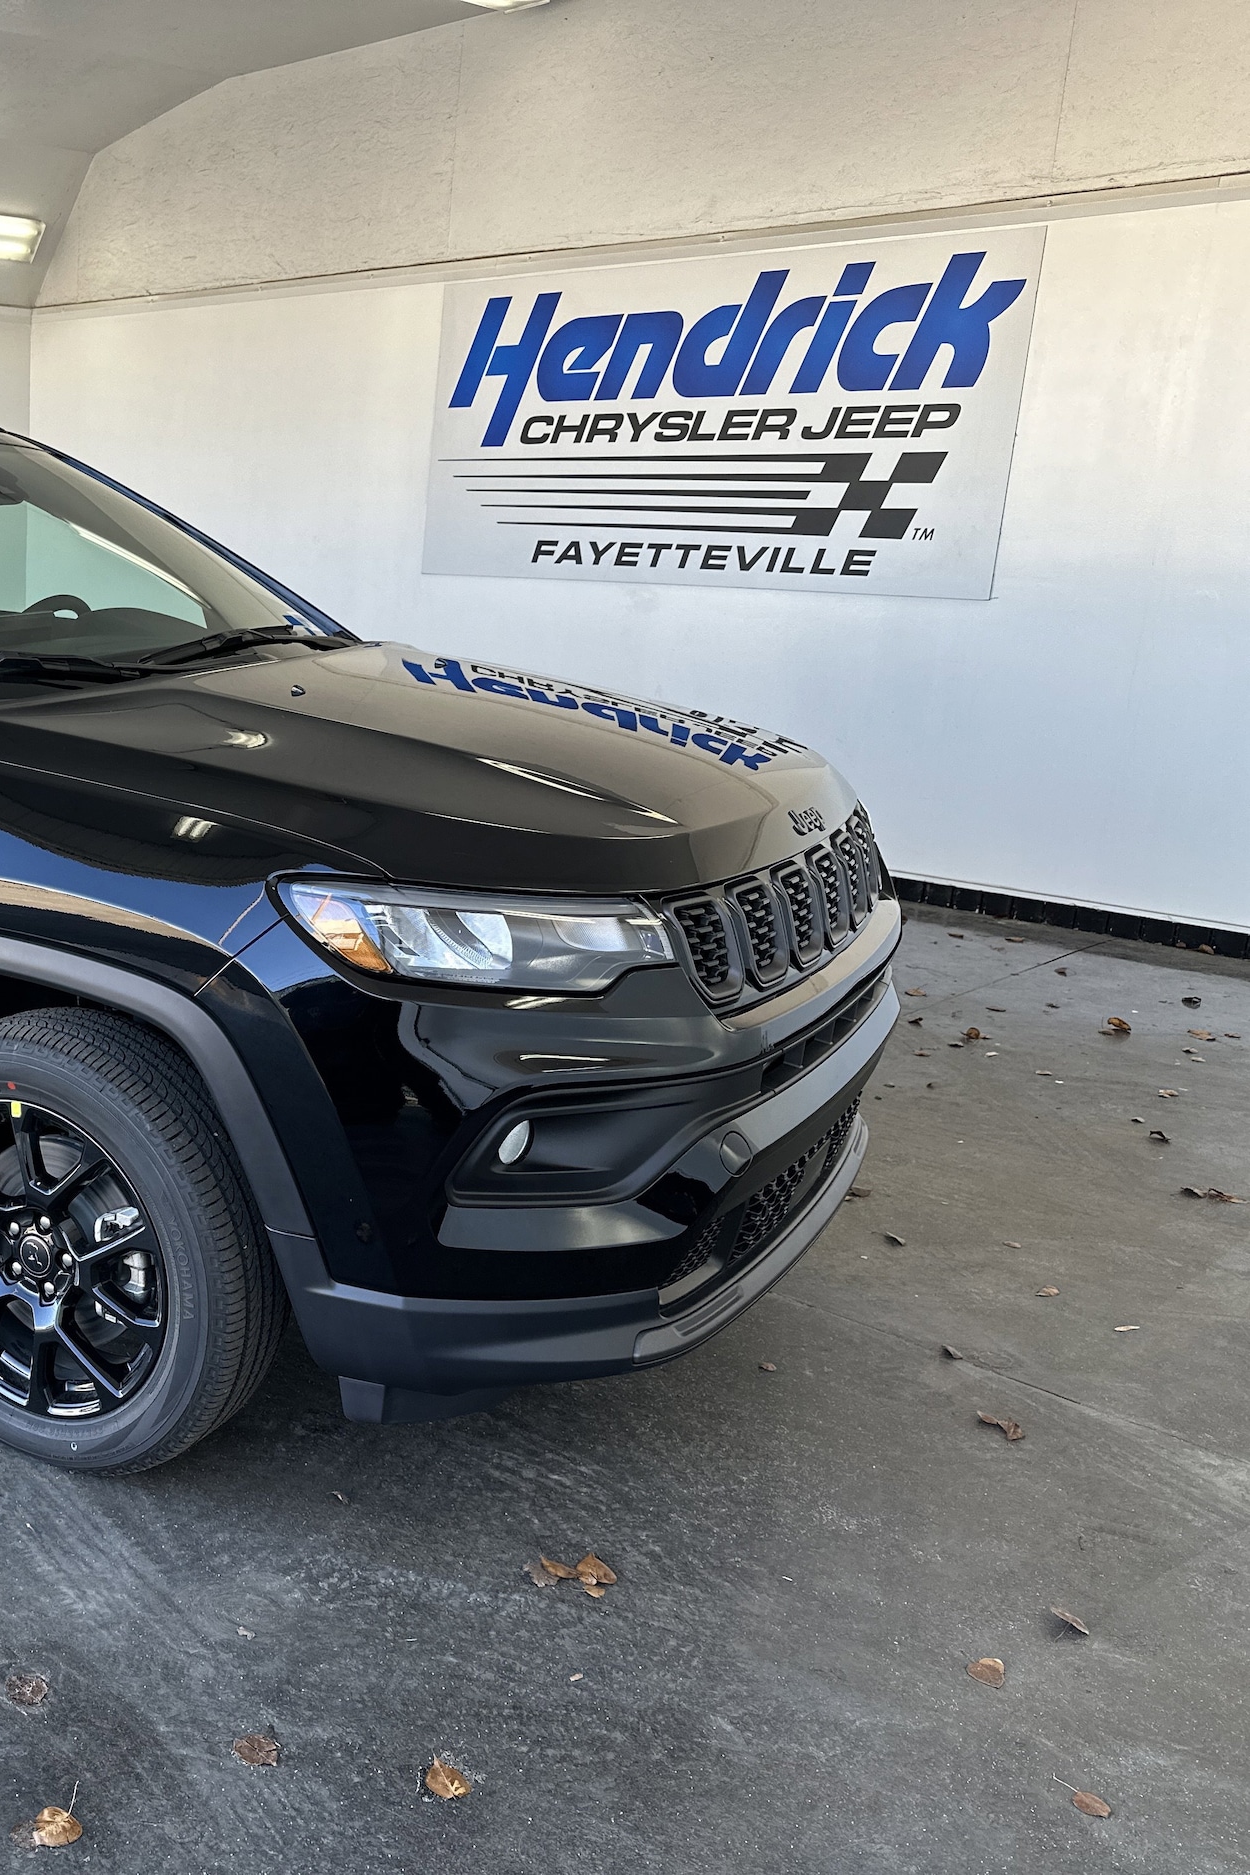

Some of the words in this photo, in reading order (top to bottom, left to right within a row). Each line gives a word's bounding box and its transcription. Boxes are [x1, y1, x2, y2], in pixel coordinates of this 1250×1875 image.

[447, 250, 1028, 448] Hendrick
[518, 407, 798, 446] CHRYSLER
[800, 402, 963, 442] JEEP
[911, 527, 936, 541] TM
[530, 540, 878, 578] FAYETTEVILLE
[168, 1215, 196, 1321] YOKOHAMA
